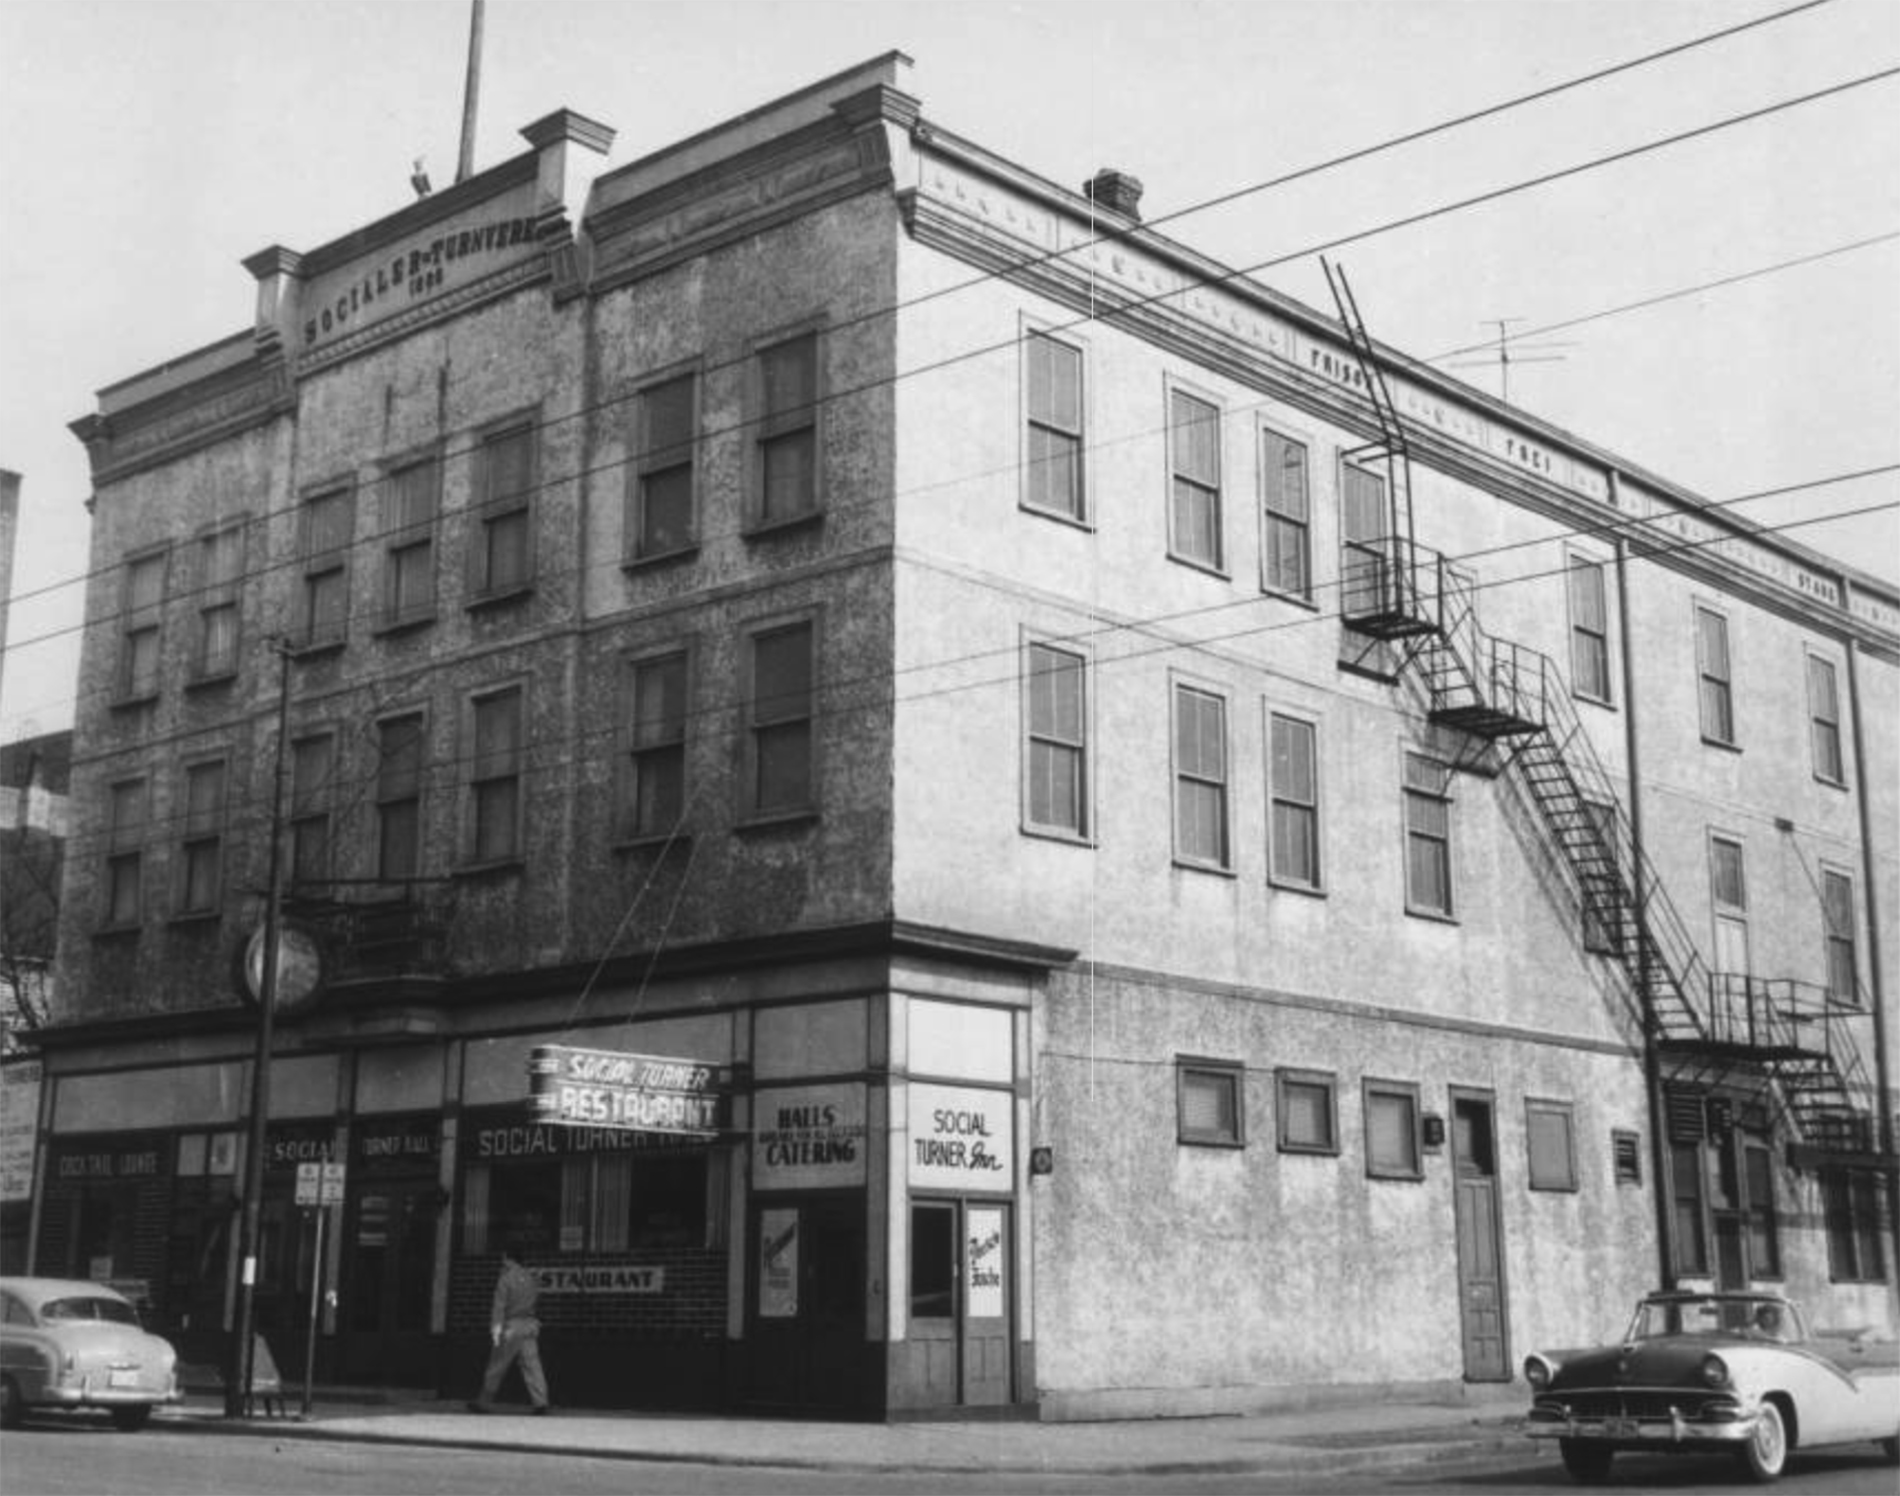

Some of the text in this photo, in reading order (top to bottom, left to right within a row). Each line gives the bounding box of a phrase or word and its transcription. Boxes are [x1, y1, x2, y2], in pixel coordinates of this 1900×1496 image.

[567, 1054, 711, 1090] SOCIAL TURNER
[560, 1086, 716, 1128] RESTAURANT
[777, 1104, 836, 1129] HALLS
[933, 1109, 992, 1137] SOCIAL
[478, 1127, 556, 1156] SOCIAL
[766, 1138, 856, 1167] CATERING
[914, 1138, 967, 1167] TURNER
[540, 1271, 653, 1288] STAURANT
